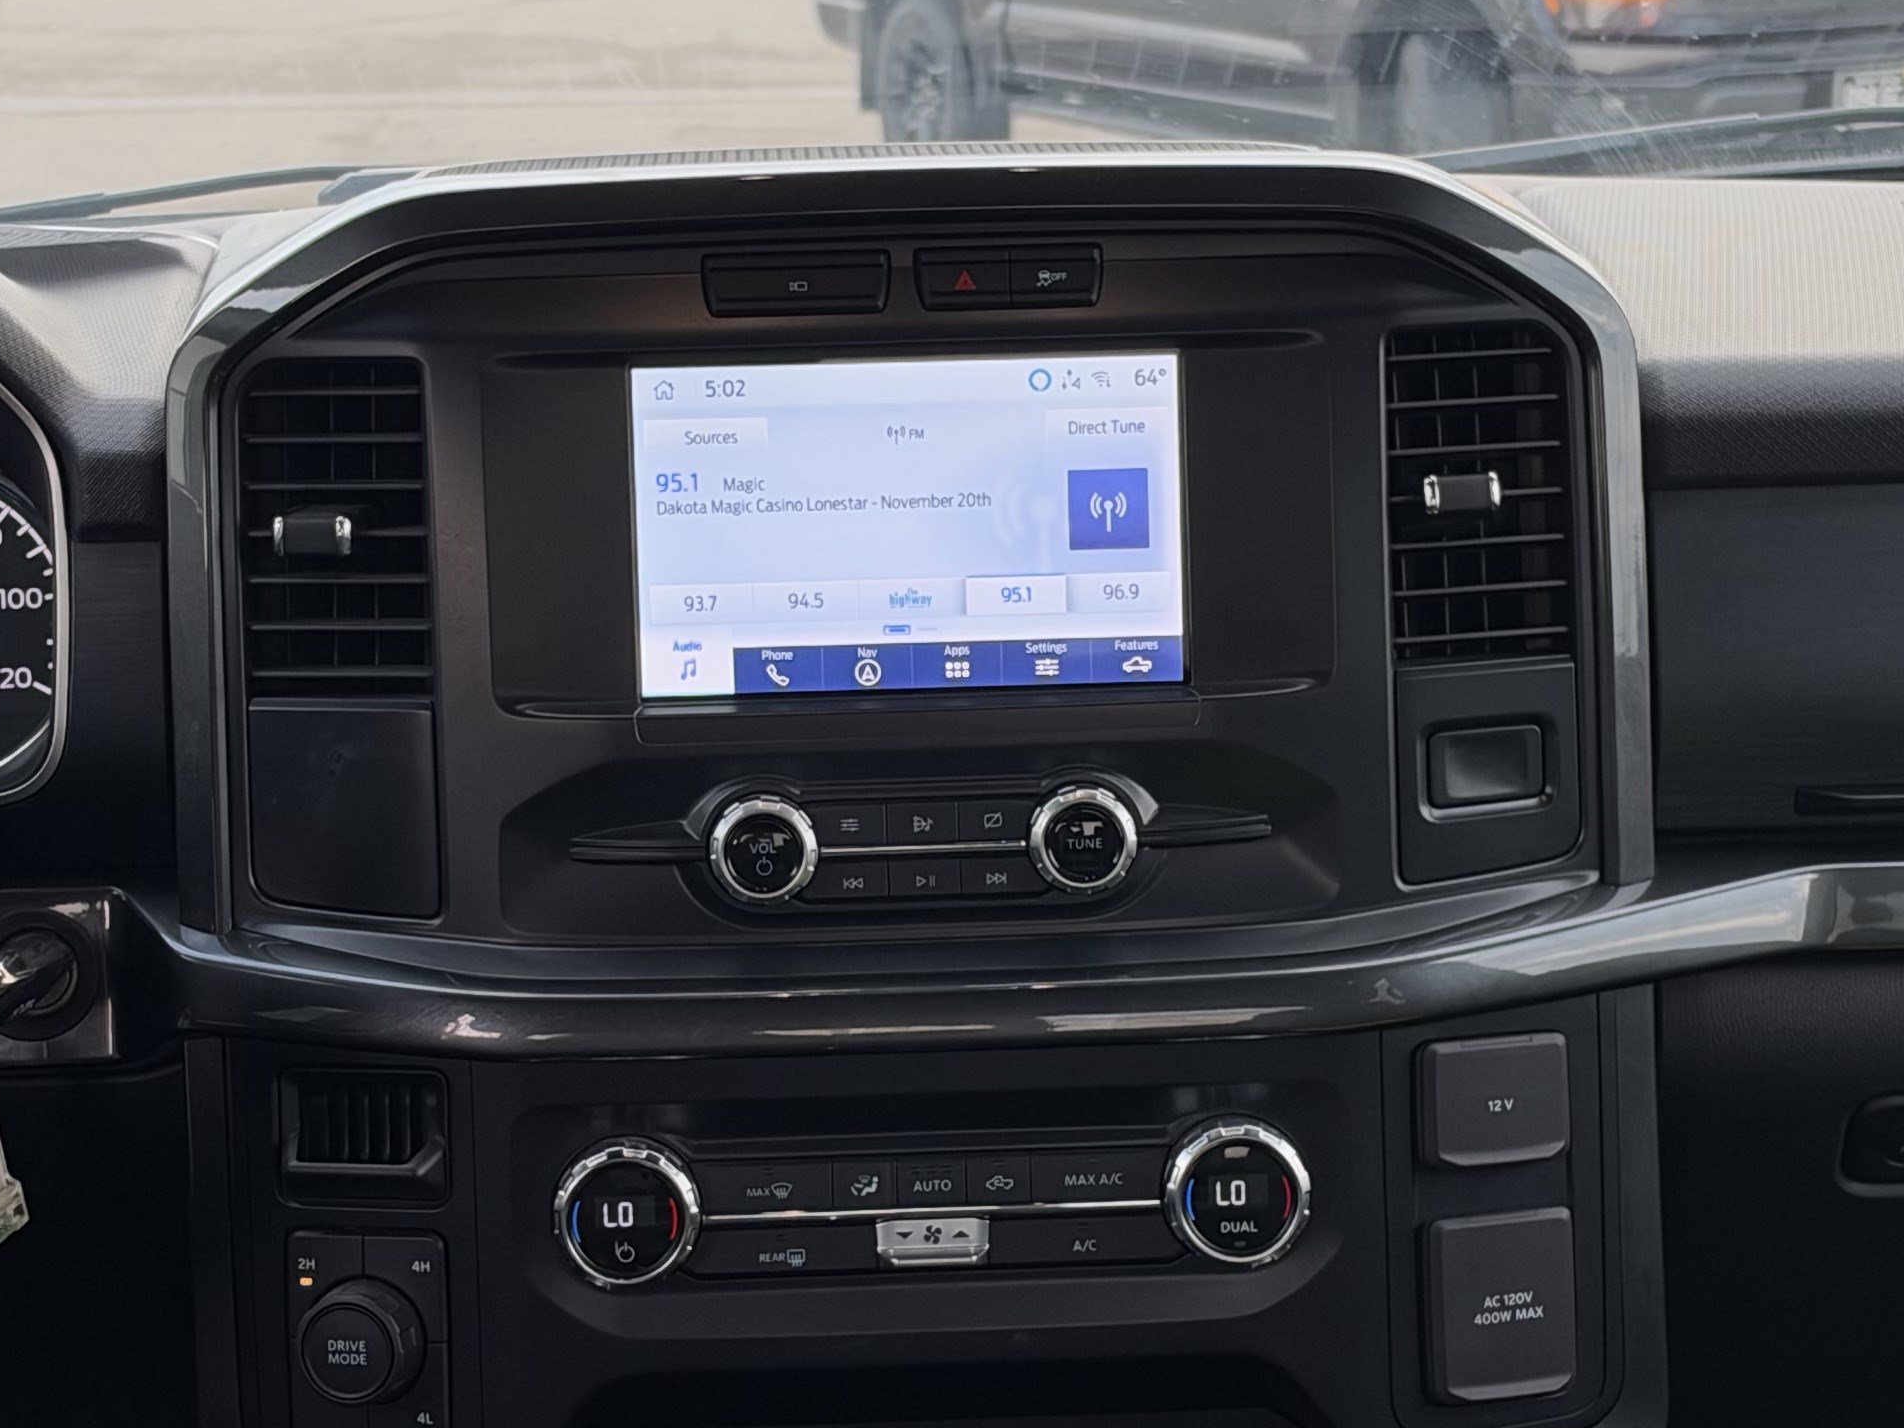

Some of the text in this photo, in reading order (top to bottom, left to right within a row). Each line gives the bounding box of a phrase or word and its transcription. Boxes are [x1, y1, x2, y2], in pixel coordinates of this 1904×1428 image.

[1051, 271, 1068, 282] OFF
[1134, 368, 1167, 388] 64°
[705, 379, 746, 399] 5:02
[909, 428, 925, 440] FM
[1068, 418, 1146, 436] Direct Tune
[684, 429, 738, 446] Sources
[655, 473, 765, 495] 95.1 Magic
[656, 499, 707, 516] Dakota
[710, 498, 753, 517] Magic
[756, 497, 803, 514] Casino
[807, 495, 868, 513] Lonestar
[880, 493, 954, 510] November
[957, 492, 992, 509] 20th
[889, 591, 932, 608] highway
[1001, 586, 1033, 604] 95.1
[1102, 583, 1140, 602] 96.9
[684, 594, 718, 613] 93.7
[787, 592, 825, 610] 94.5
[673, 640, 703, 653] Audio
[857, 647, 878, 660] Nav
[943, 644, 971, 659] Apps
[1025, 641, 1068, 657] Settings
[1114, 639, 1159, 653] Features
[761, 649, 794, 663] Phone
[750, 841, 776, 855] VOL
[1067, 837, 1103, 851] TUNE
[913, 1179, 952, 1193] AUTO
[1064, 1171, 1123, 1188] MAX A/C
[747, 1186, 771, 1198] MAX
[1215, 1180, 1246, 1207] LO
[602, 1202, 634, 1228] LO
[1220, 1220, 1258, 1234] DUAL
[1073, 1238, 1098, 1254] A/C
[298, 1258, 316, 1270] 2H
[759, 1251, 785, 1264] REAR
[411, 1261, 431, 1273] 4H
[1484, 1292, 1533, 1308] AC 120V
[1474, 1306, 1544, 1325] 400W MAX
[327, 1340, 367, 1352] DRIVE
[327, 1353, 368, 1365] MODE
[417, 1412, 434, 1425] 4L
